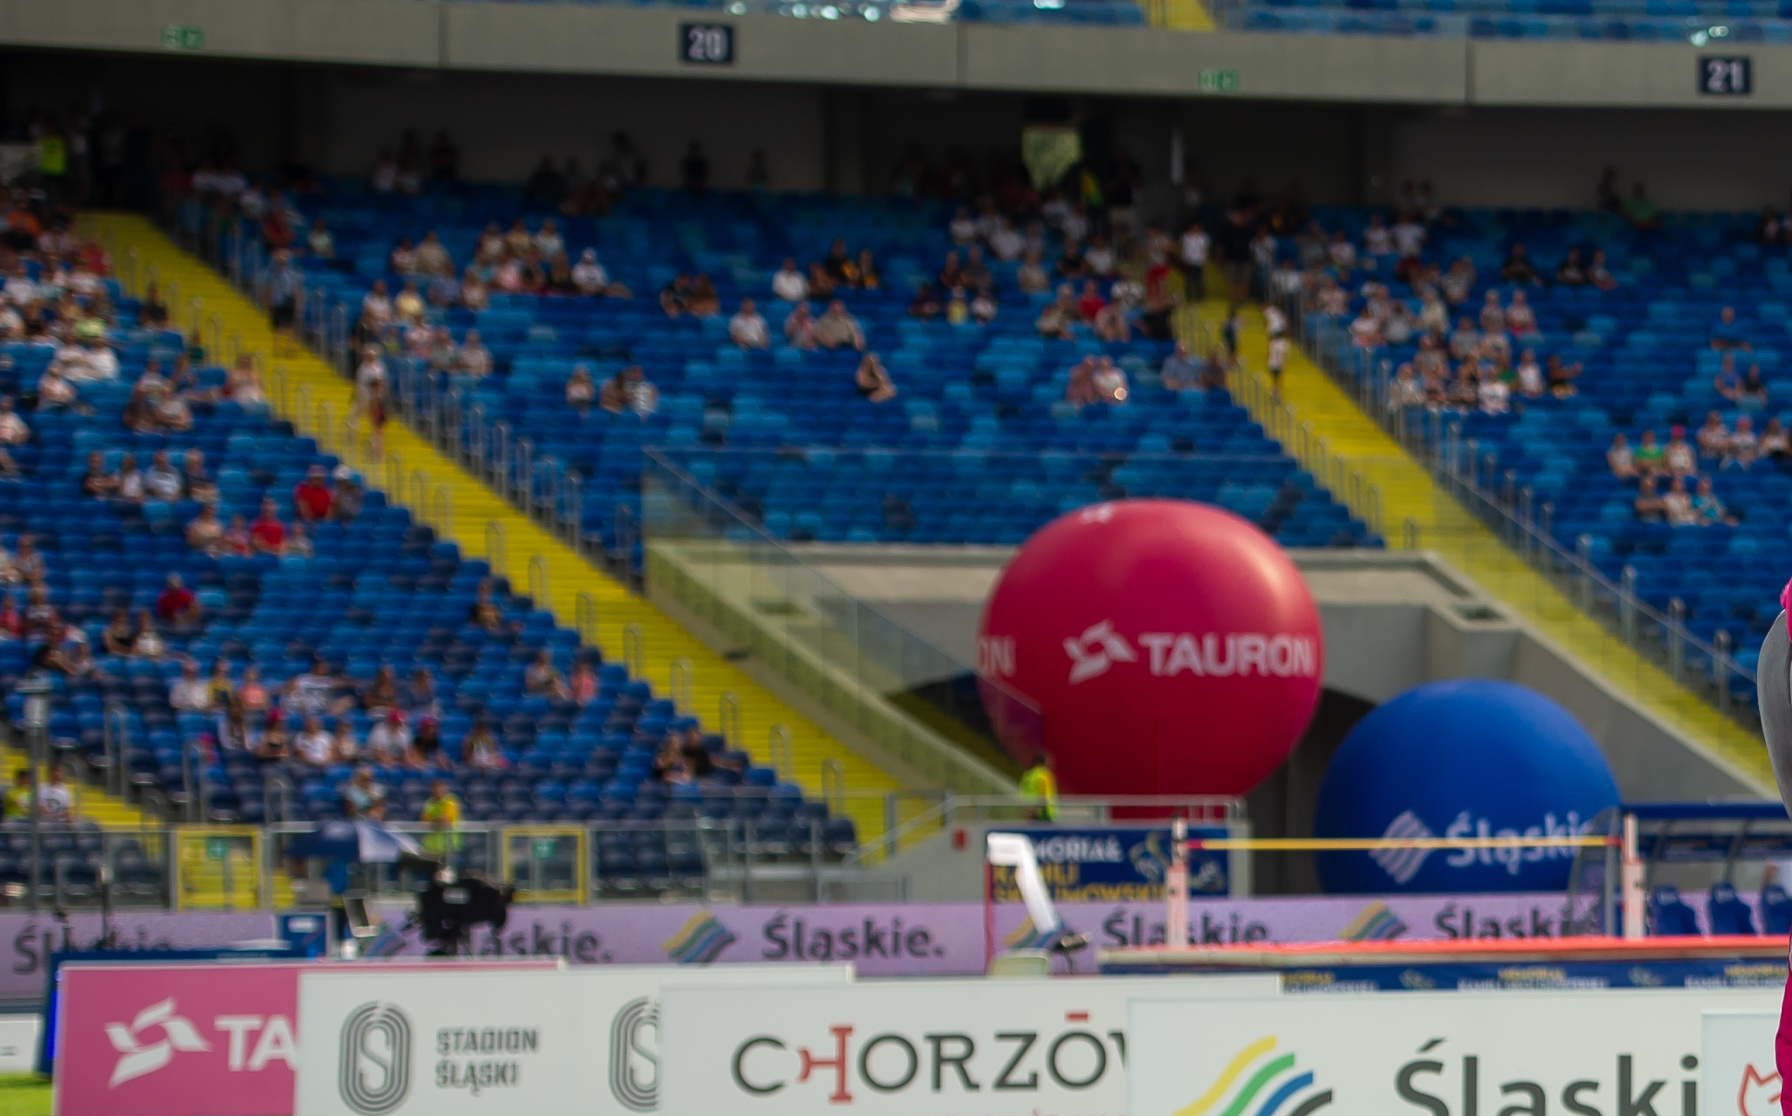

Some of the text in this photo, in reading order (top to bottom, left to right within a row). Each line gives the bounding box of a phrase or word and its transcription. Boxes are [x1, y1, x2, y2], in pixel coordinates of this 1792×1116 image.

[688, 26, 728, 61] 20
[1707, 60, 1744, 92] 21
[1138, 631, 1316, 677] TAURON
[436, 1027, 540, 1055] STADION
